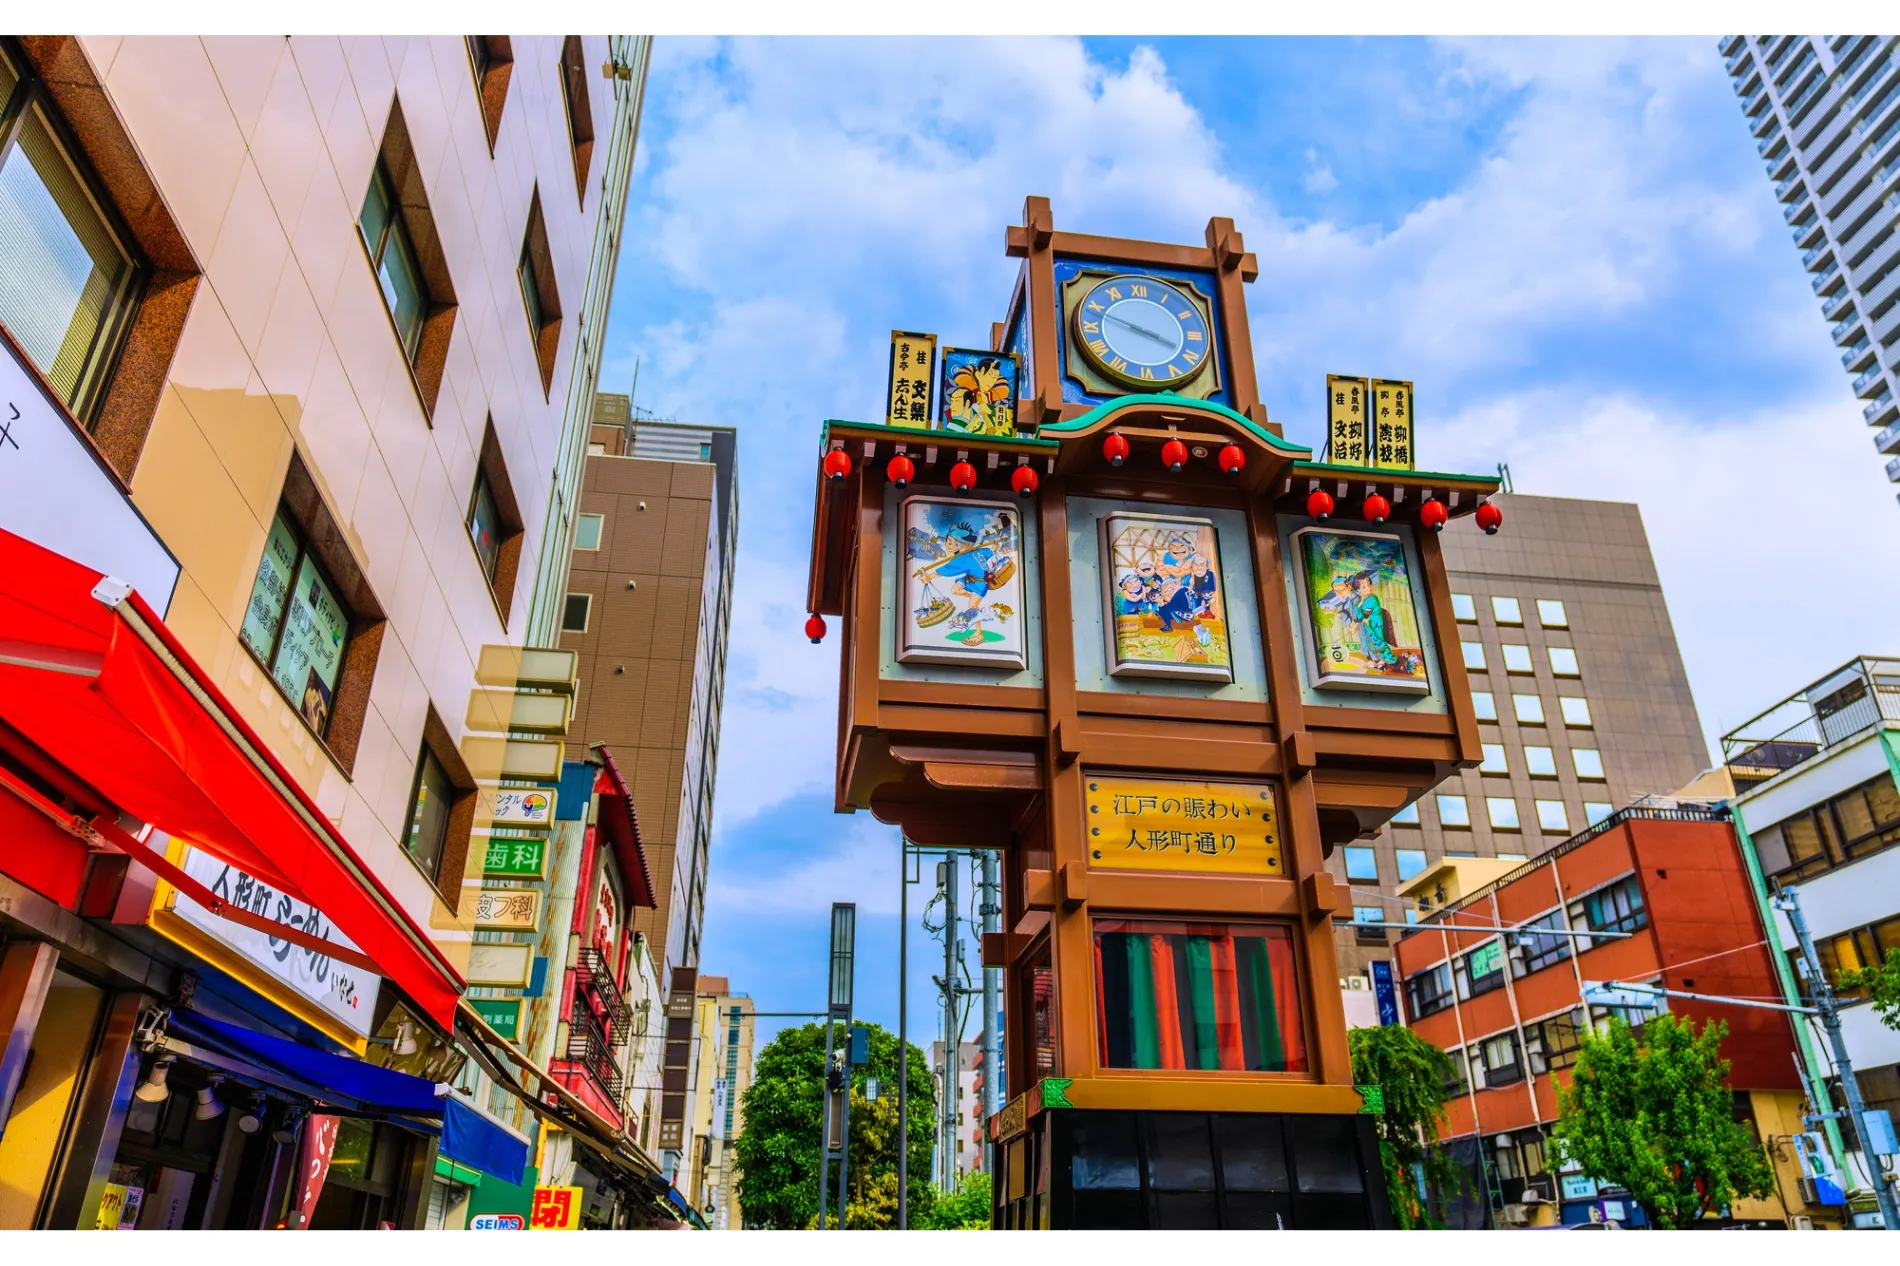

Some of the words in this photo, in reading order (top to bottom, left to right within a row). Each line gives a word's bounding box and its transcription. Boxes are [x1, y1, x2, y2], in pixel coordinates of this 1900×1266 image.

[916, 350, 927, 365] 桂
[1113, 793, 1251, 820] 江戸の賑わい
[1125, 828, 1236, 855] 人形町通り
[485, 843, 539, 871] 歯科
[475, 1219, 519, 1230] SEIMS
